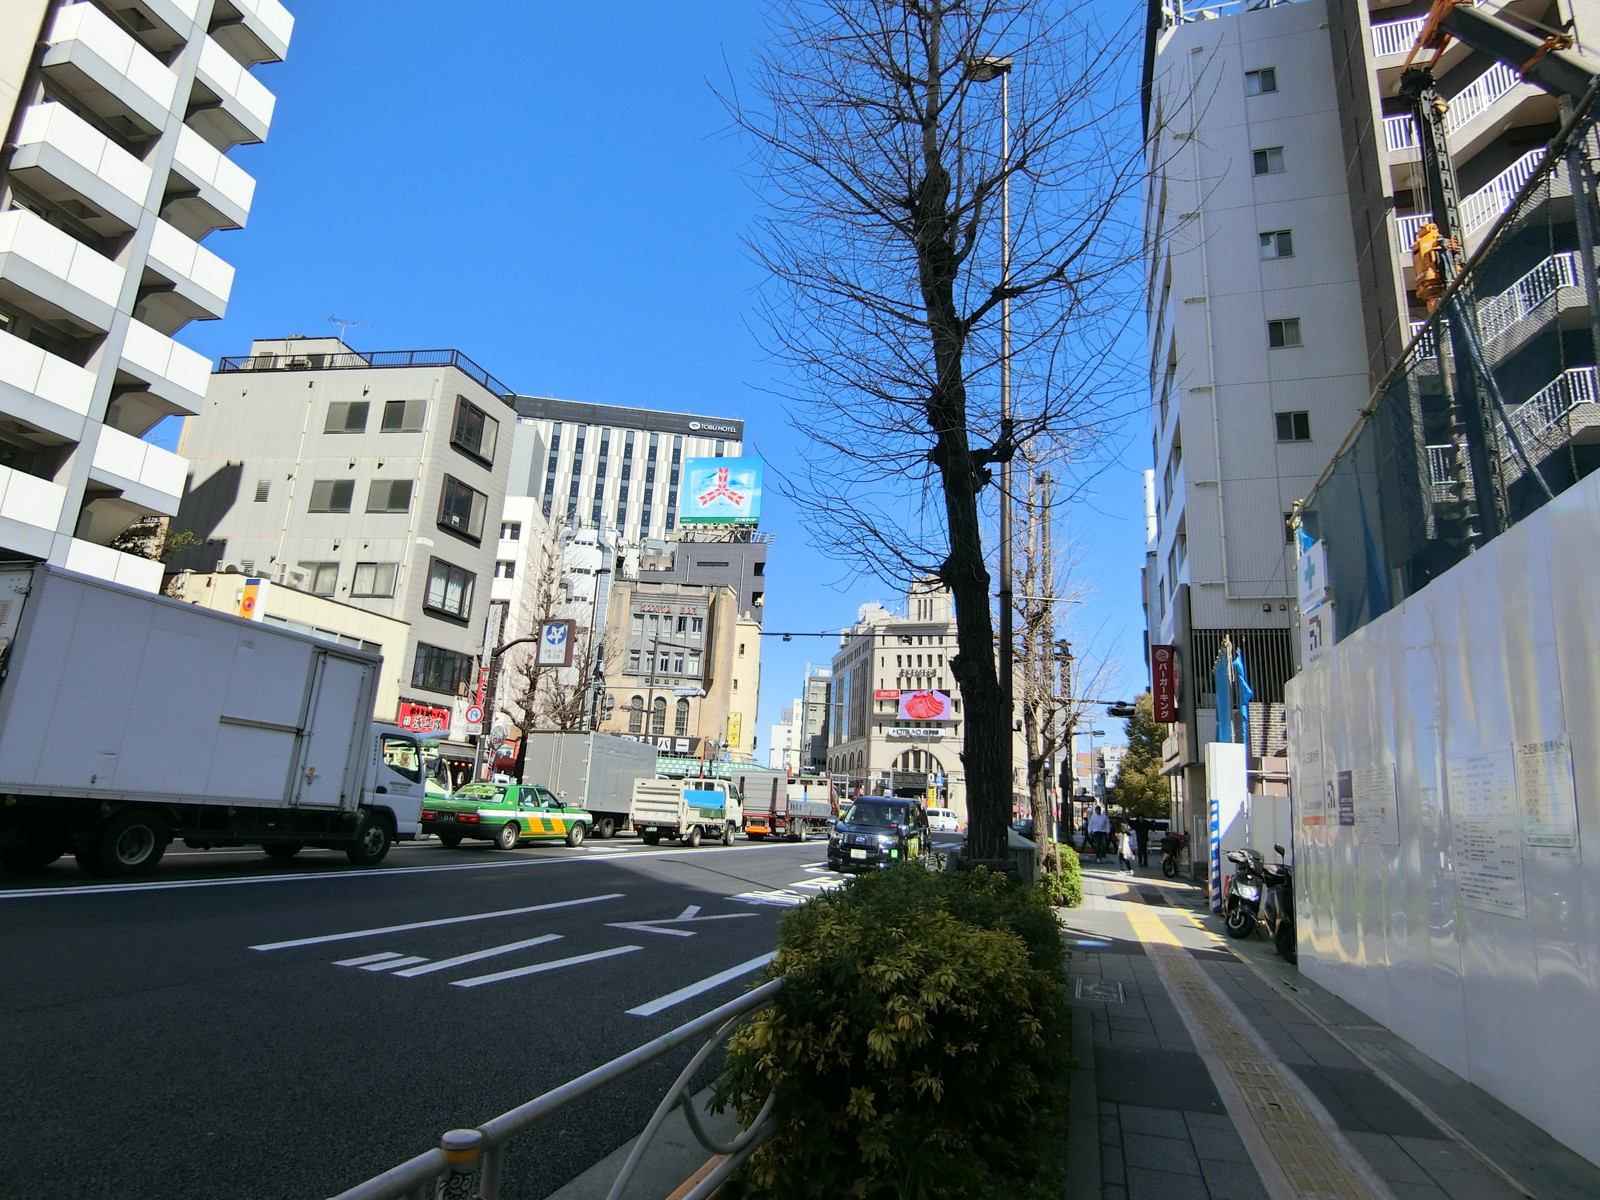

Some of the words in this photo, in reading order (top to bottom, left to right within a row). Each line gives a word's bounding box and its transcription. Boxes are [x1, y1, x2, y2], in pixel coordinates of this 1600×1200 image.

[701, 423, 718, 431] TOBU
[718, 425, 737, 433] HOTEL
[680, 606, 698, 615] BAR
[1158, 663, 1169, 719] バーガーキング
